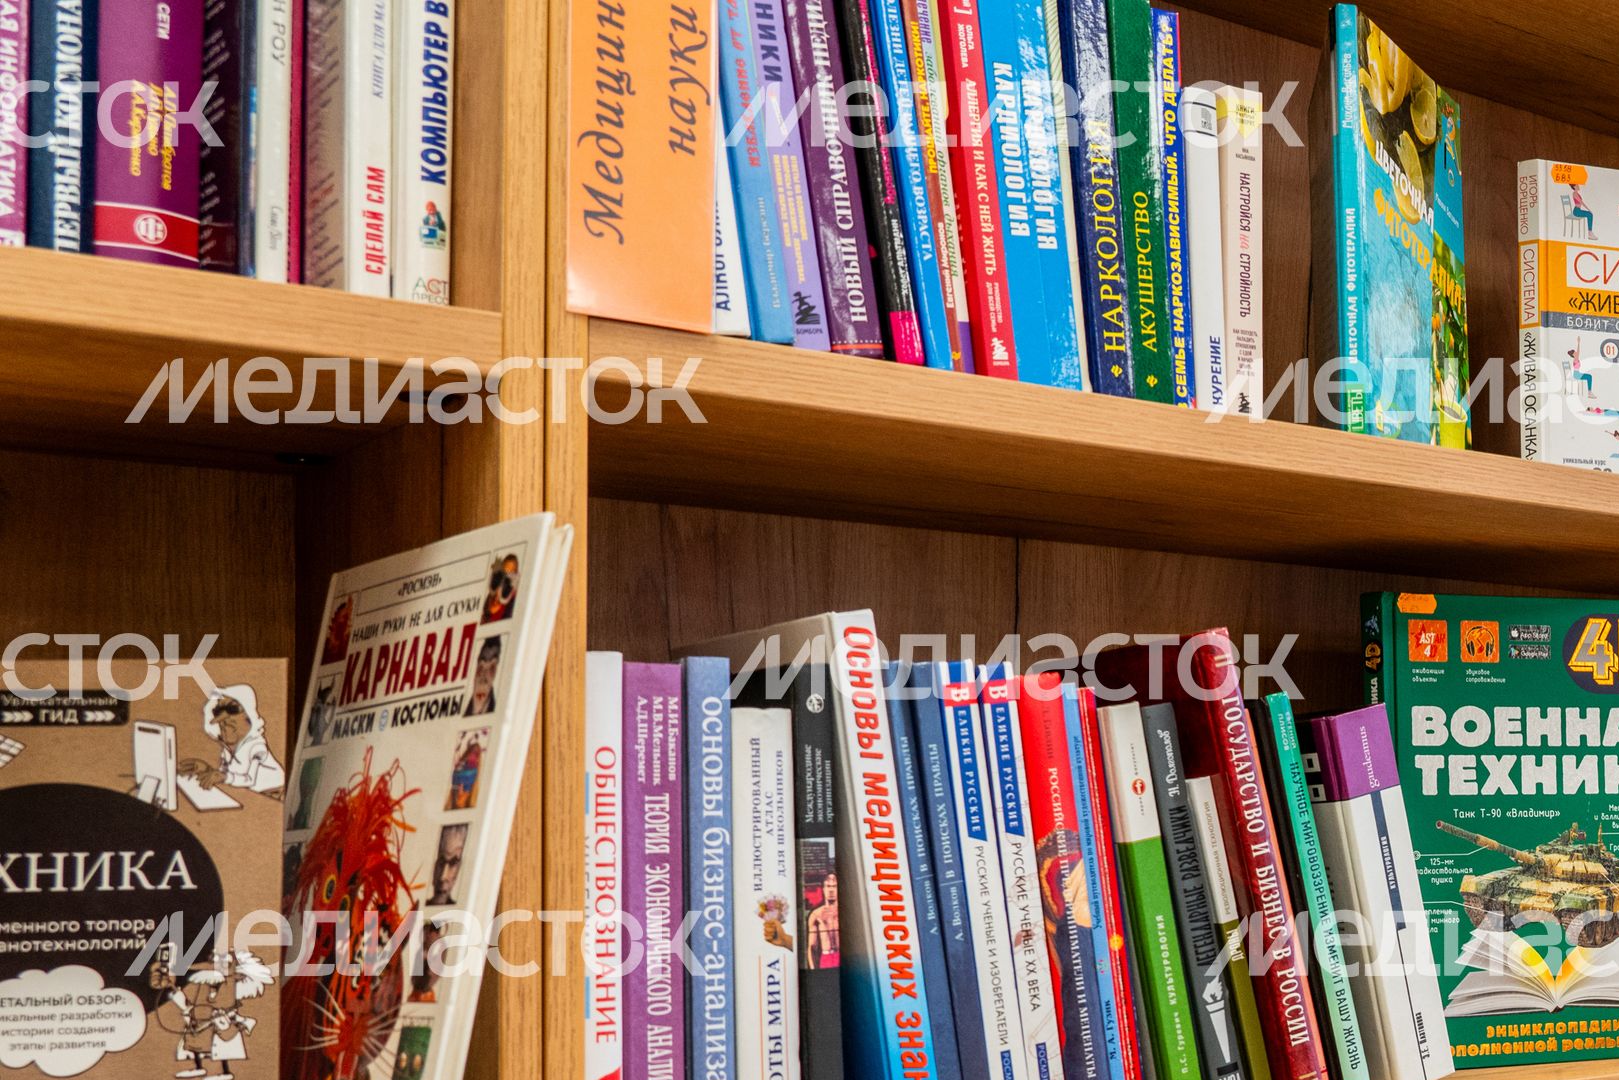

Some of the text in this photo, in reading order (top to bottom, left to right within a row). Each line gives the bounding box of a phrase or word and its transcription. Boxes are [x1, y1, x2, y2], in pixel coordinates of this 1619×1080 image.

[420, 1, 449, 185] КОМПЬЮТЕР В
[668, 5, 711, 155] науки
[1163, 23, 1182, 104] ДЕЛАТЬ?
[993, 61, 1031, 237] КАРДИОЛОГИЯ
[1172, 115, 1184, 147] ЧТО
[366, 166, 386, 276] СДЕЛАЙ САМ
[1092, 118, 1126, 353] НАРКОЛОГИЯ
[1239, 172, 1253, 318] НАСТРОЙСЯ на СТРОЙНОСТЬ
[835, 238, 868, 323] НОВЫЙ
[1134, 192, 1157, 353] АКУШЕРСТВО
[1567, 316, 1612, 330] БОЛИТ
[1604, 343, 1617, 357] 01
[1173, 338, 1190, 399] СЕМЬЕ
[352, 598, 482, 643] НАШИ РУКИ НЕ ДЛЯ СКУКИ
[338, 623, 477, 706] КАРНАВАЛ
[39, 710, 77, 724] ГИД
[332, 695, 464, 739] МАСКИ КОСТЮМЫ
[701, 696, 723, 818] ОСНОВЫ
[644, 792, 670, 855] ТЕОРИЯ
[1453, 808, 1561, 820] Танк Т-90 «Владимир»
[594, 745, 617, 1044] ОБЩЕСТВОЗНАНИЕ
[1224, 695, 1310, 1048] ГОСУДАРСТВО И БИЗНЕС В РОССИИ
[85, 919, 155, 934] топора
[644, 862, 672, 1016] ЭКОНОМИЧЕСКОГО
[1290, 761, 1361, 1071] НАУЧНОЕ МИРОВОЗЗРЕНИЕ ИЗМЕНИТ ВАШУ ЖИЗНЬ
[1, 1025, 115, 1037] истории создания
[60, 1009, 132, 1023] разработки
[76, 995, 126, 1006] ОБЗОР:
[768, 958, 781, 1026] МИРА
